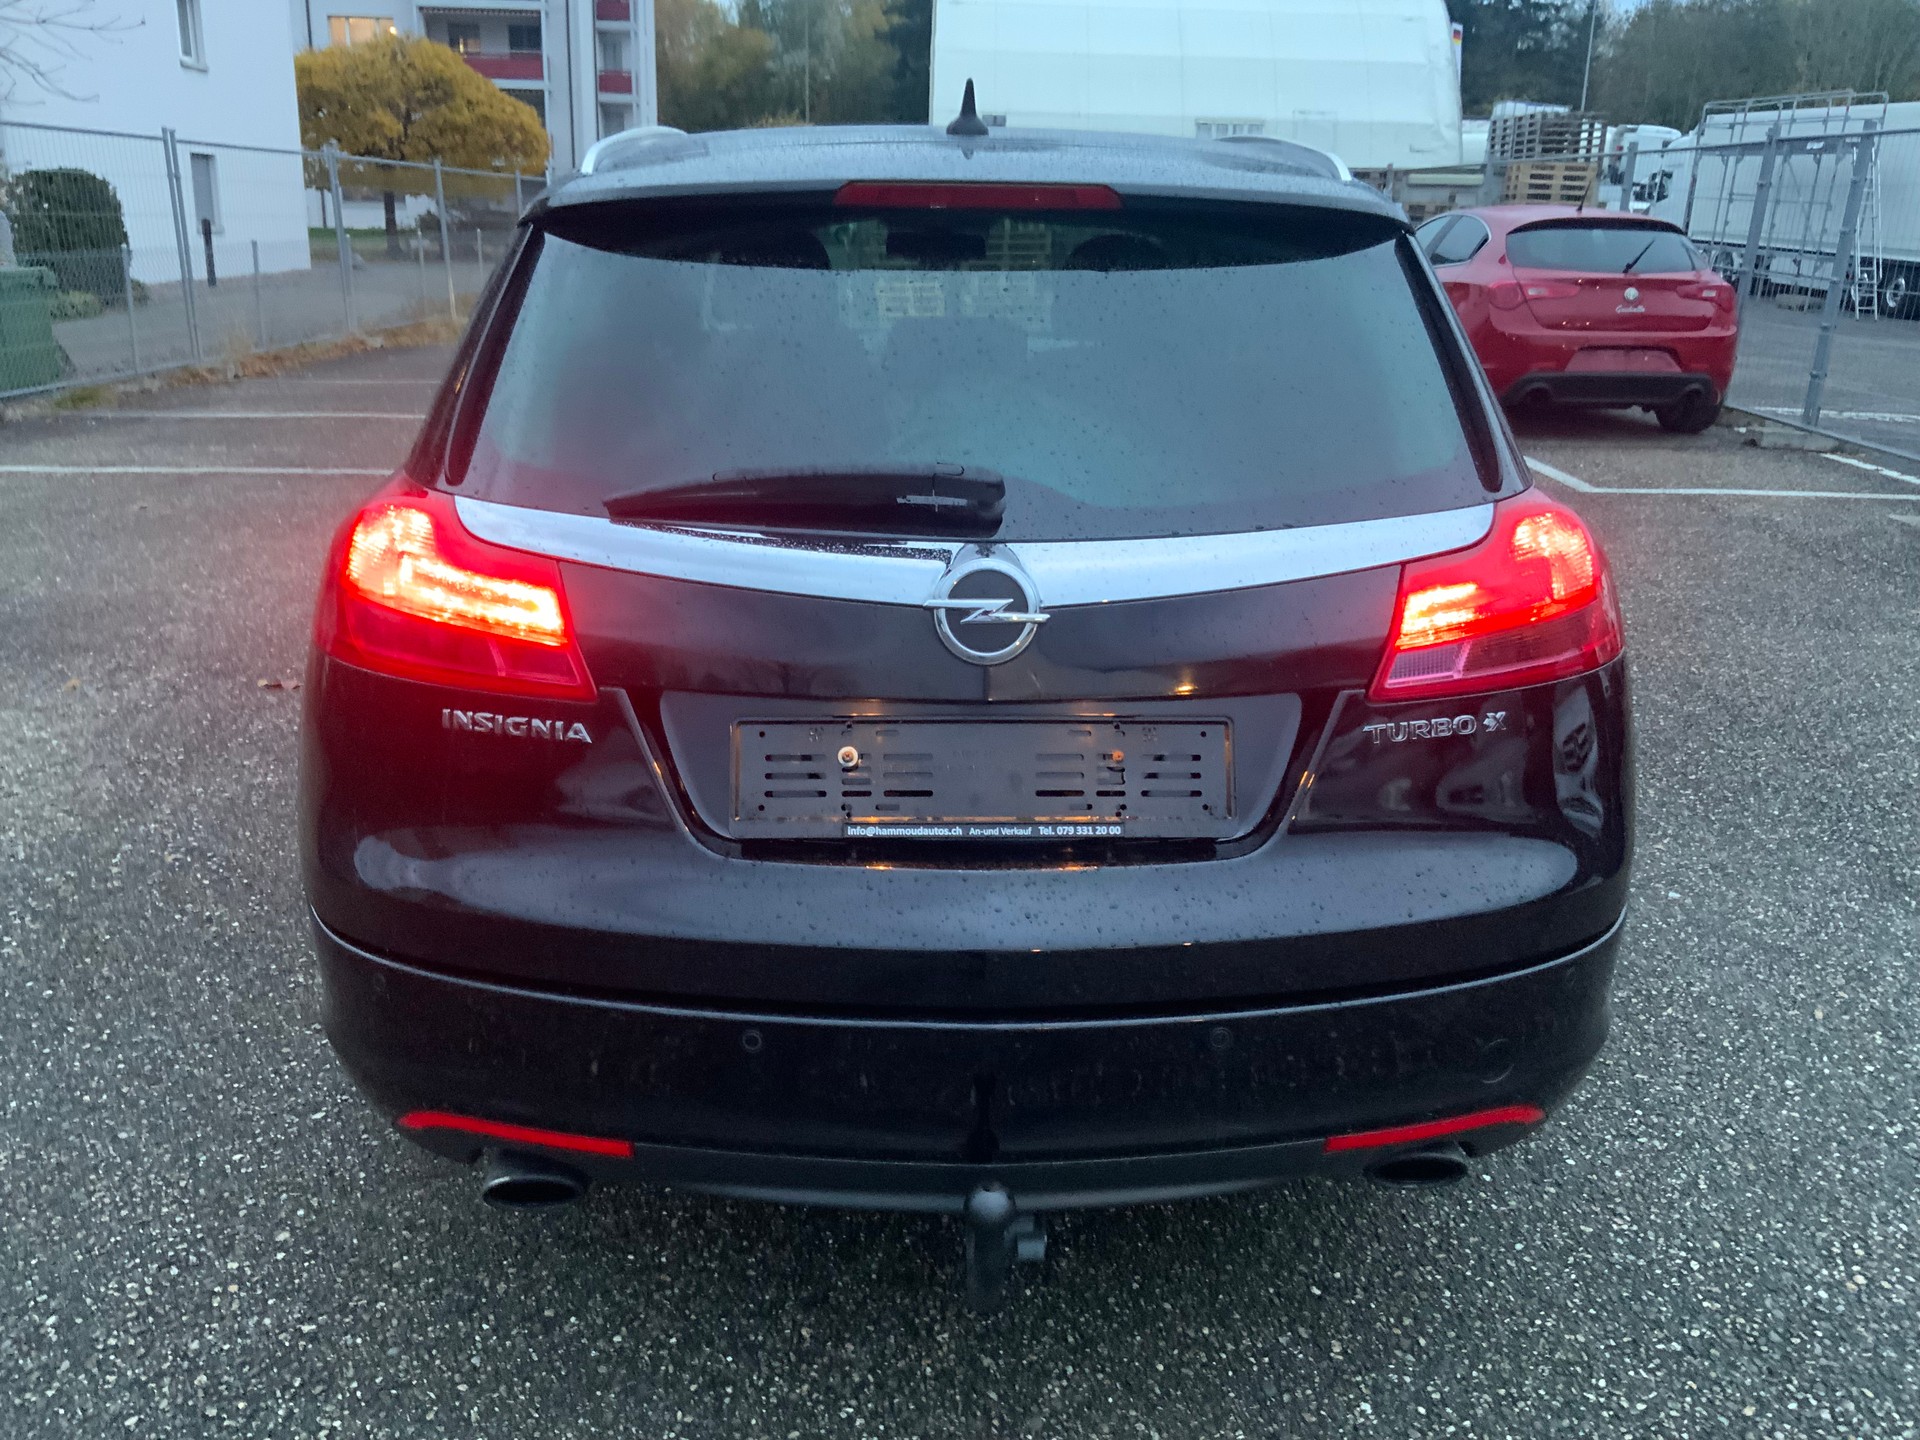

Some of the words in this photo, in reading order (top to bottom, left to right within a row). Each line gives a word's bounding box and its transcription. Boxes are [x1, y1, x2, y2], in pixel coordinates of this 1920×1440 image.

[441, 708, 593, 744] INSIGNIA
[1363, 714, 1477, 744] TURBO
[847, 826, 962, 837] info@hammoudautos.ch
[969, 827, 999, 836] An-und
[1001, 826, 1032, 836] Verkauf
[1038, 826, 1055, 836] Tel.
[1056, 826, 1075, 836] 079
[1076, 826, 1093, 836] 331
[1095, 826, 1107, 836] 20
[1108, 826, 1121, 836] 00
